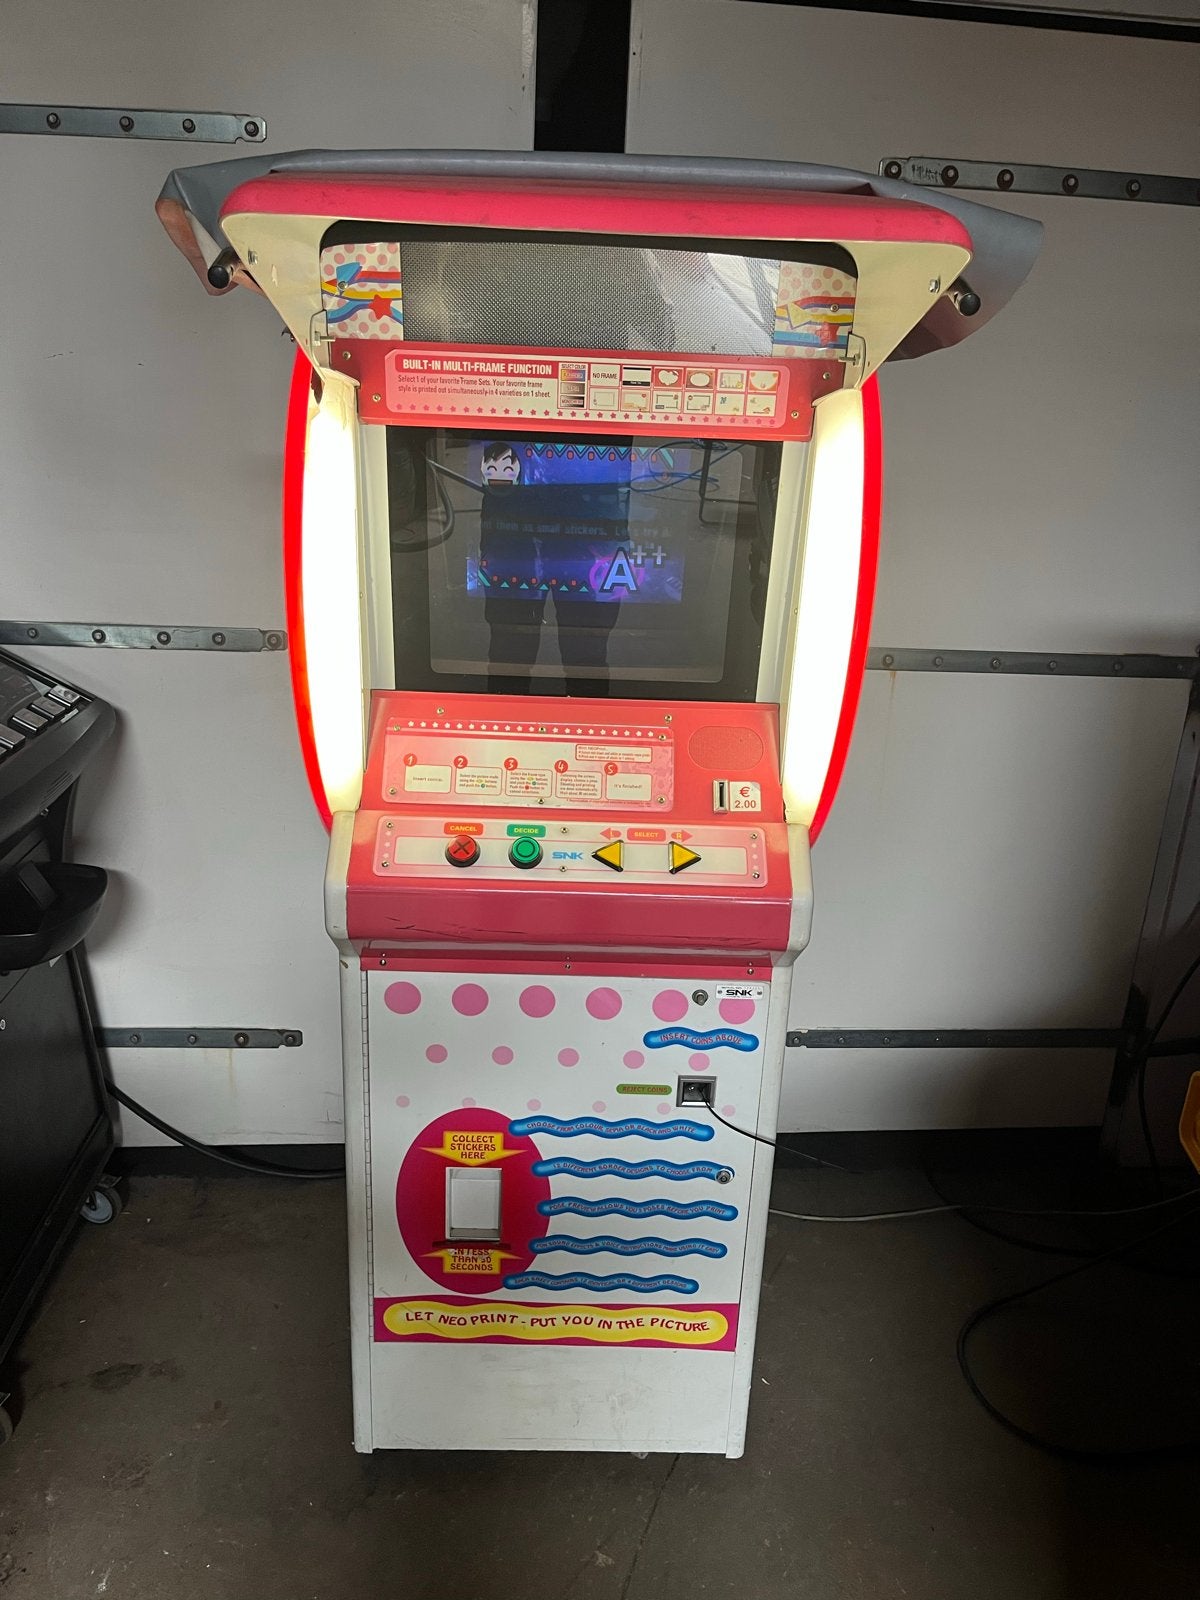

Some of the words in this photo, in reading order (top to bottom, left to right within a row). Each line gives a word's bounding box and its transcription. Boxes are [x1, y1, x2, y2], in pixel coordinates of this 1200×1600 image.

[402, 359, 441, 371] BUILT-IN
[443, 361, 506, 373] MULTI-FRAME
[507, 363, 552, 375] FUNCTION
[398, 375, 415, 383] Select
[420, 376, 426, 384] of
[439, 377, 460, 385] favorite
[460, 377, 478, 386] Frame
[492, 379, 505, 387] Your
[506, 379, 527, 388] favorite
[527, 381, 543, 389] frame
[398, 385, 411, 393] style
[412, 385, 418, 393] is
[418, 386, 438, 395] printed
[447, 387, 488, 397] simultaneously
[495, 388, 498, 396] 4
[531, 390, 534, 398] 1
[408, 755, 414, 765] 1
[457, 757, 464, 768] 2
[507, 759, 514, 770] 3
[558, 761, 564, 772] 4
[607, 765, 614, 774] 5
[739, 786, 751, 798] €
[734, 800, 757, 809] 2.00
[551, 851, 584, 860] SNK
[660, 1032, 690, 1042] INSERT
[691, 1036, 714, 1045] COINS
[715, 1033, 743, 1045] ABOVE
[526, 1121, 555, 1130] CHOOSE
[636, 1124, 657, 1134] BLACK
[672, 1125, 696, 1133] WHITE
[452, 1135, 495, 1143] COLLECT
[450, 1143, 496, 1152] STICKERS
[460, 1151, 486, 1160] HERE
[563, 1162, 597, 1173] DIFFERENT
[598, 1163, 626, 1172] BORDER
[626, 1165, 654, 1174] DESIGNS
[549, 1202, 565, 1210] POSE
[595, 1202, 624, 1211] ALLOWS
[667, 1206, 689, 1214] BEFORE
[705, 1206, 726, 1215] PRINT
[451, 1255, 478, 1263] THAN
[450, 1263, 493, 1271] SECONDS
[405, 1311, 434, 1322] LET
[438, 1314, 467, 1326] NEO
[470, 1313, 519, 1325] PRINT
[530, 1317, 557, 1327] PUT
[562, 1316, 594, 1326] YOU
[597, 1319, 613, 1330] IN
[616, 1317, 645, 1330] THE
[650, 1317, 710, 1332] PICTURE
